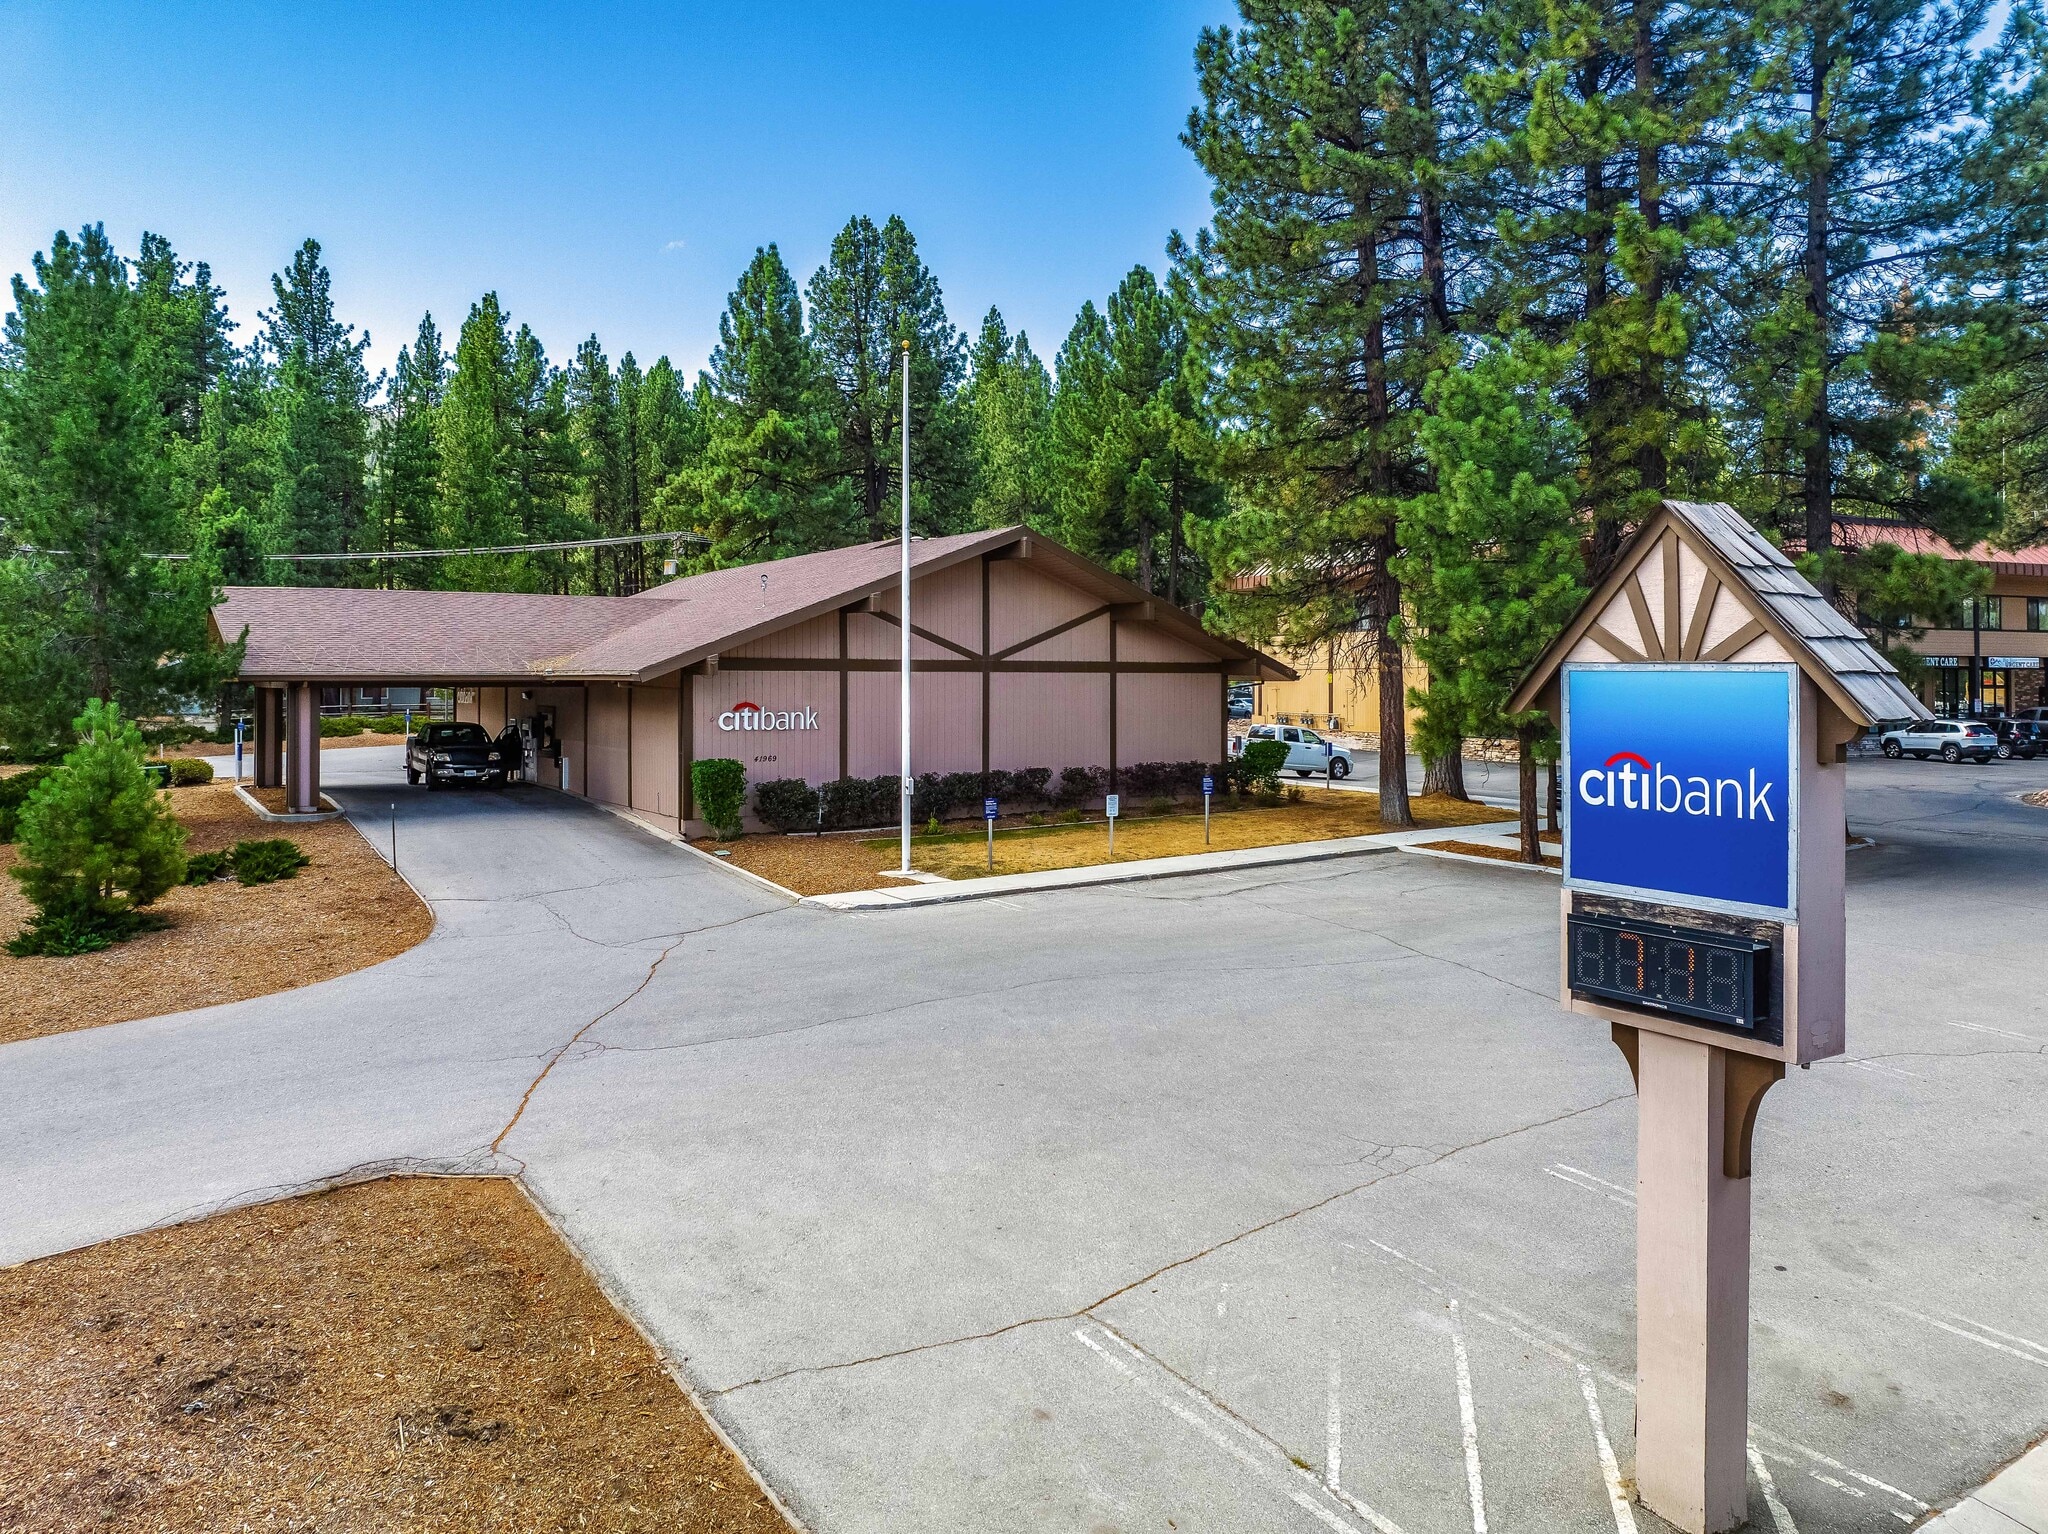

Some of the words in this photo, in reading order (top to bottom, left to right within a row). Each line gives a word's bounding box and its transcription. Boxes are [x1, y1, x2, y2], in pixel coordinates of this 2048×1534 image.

[1940, 657, 1958, 666] CARE
[718, 706, 819, 731] citibank
[1579, 761, 1775, 822] citibank
